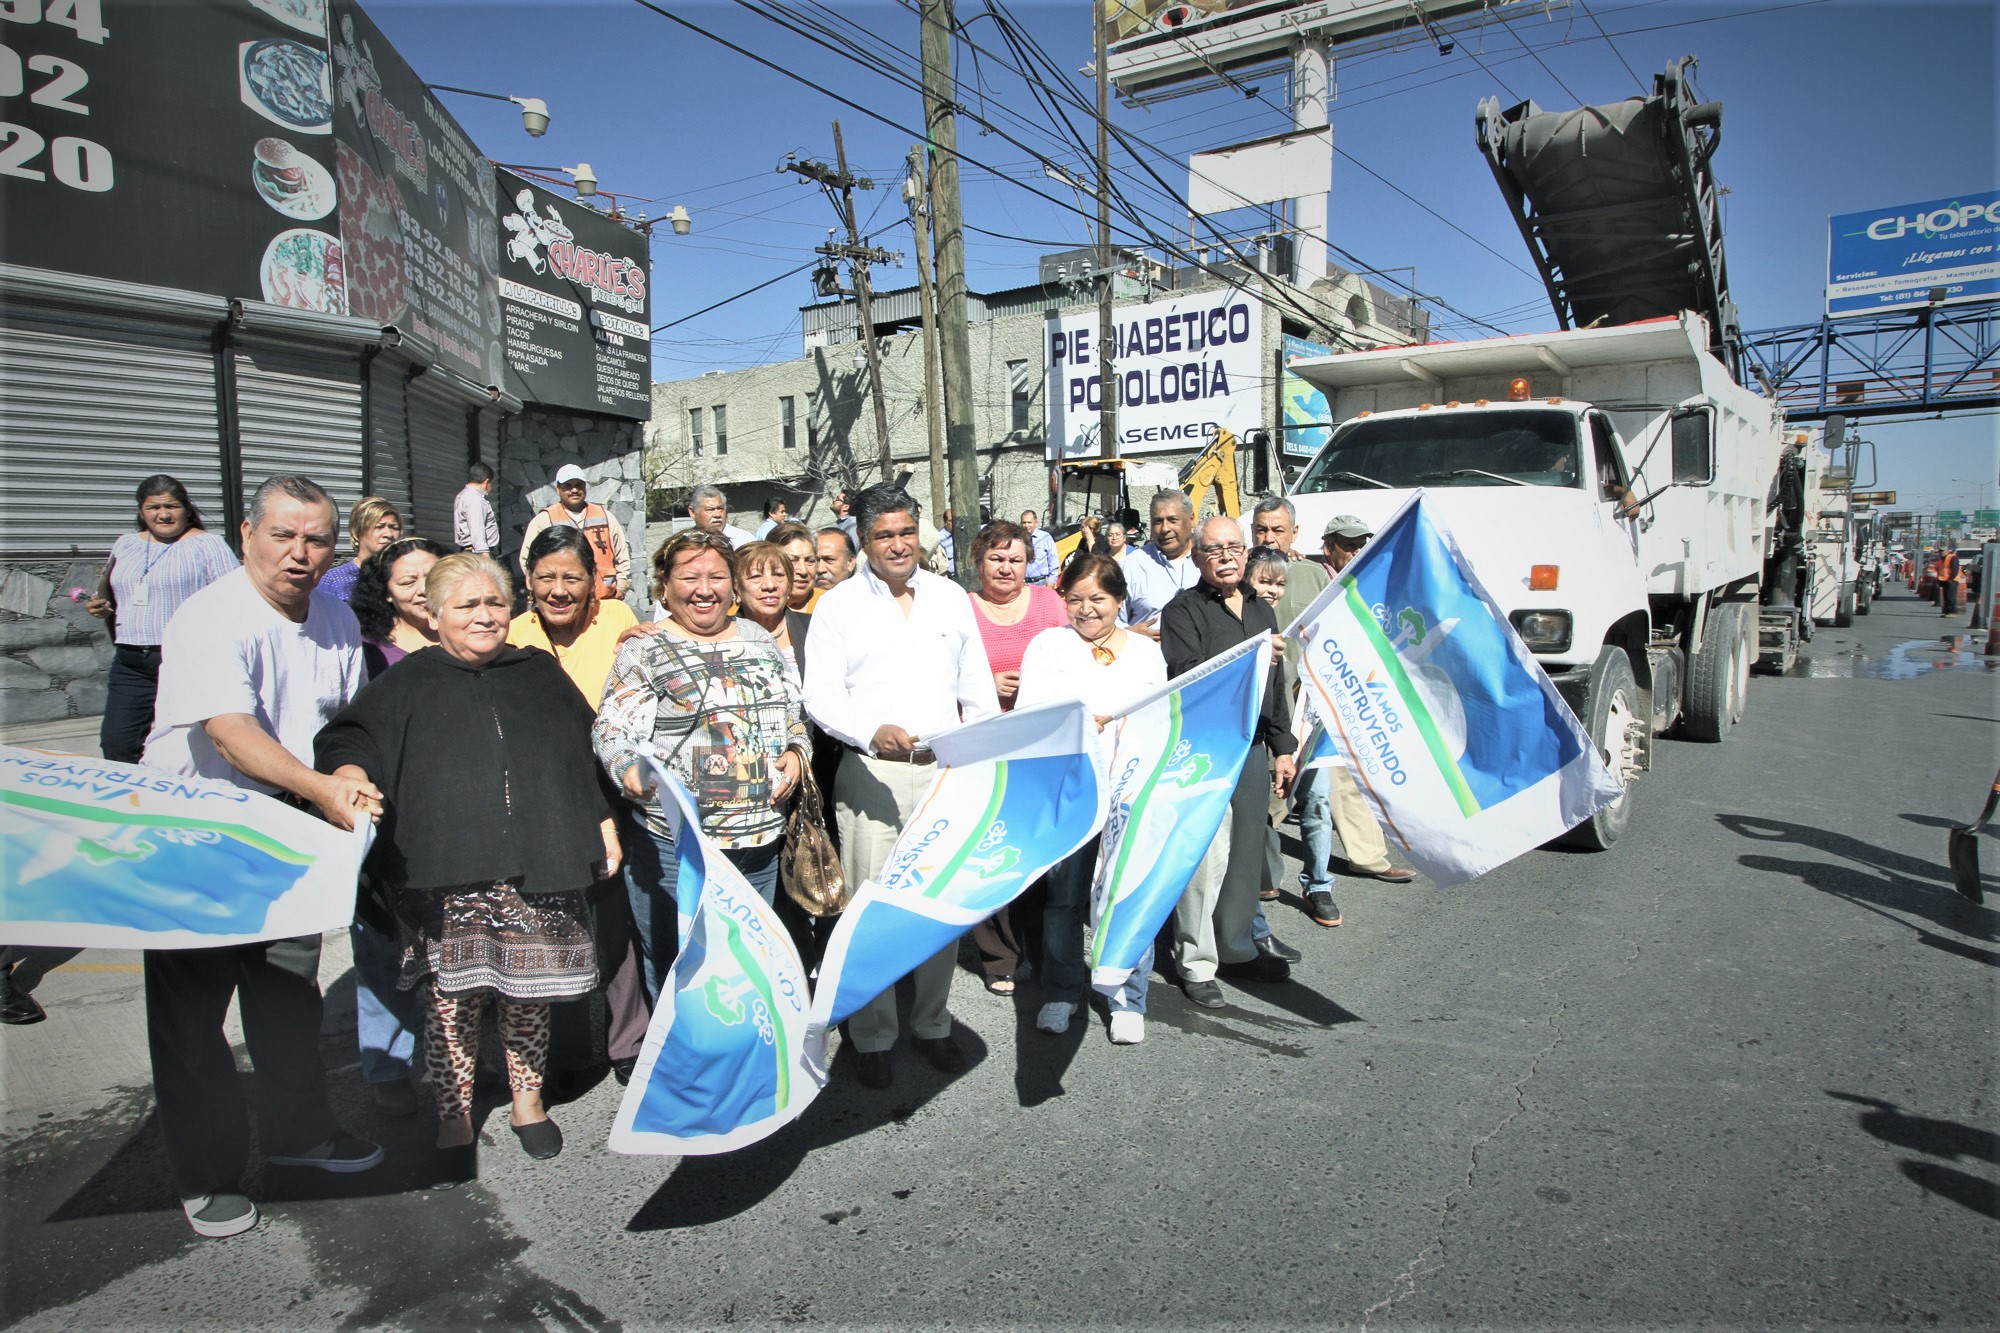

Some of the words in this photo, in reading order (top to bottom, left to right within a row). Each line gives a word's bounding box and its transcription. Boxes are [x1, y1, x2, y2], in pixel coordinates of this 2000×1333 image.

[0, 122, 113, 192] 20
[442, 136, 467, 175] TODOS
[428, 139, 444, 168] LOS
[445, 158, 480, 206] PARTIDOS
[1949, 228, 1992, 239] laboratorio
[401, 209, 479, 287] 83.32.95.94
[1902, 249, 1967, 267] ¡Llegamos
[1969, 245, 1993, 254] con
[404, 236, 479, 307] 83.52.13.92
[548, 239, 645, 299] CHARLIE'S
[1836, 270, 1878, 281] Servicios:
[404, 260, 481, 328] 83.52.39.20
[591, 288, 616, 307] pizza
[1842, 282, 1885, 293] Resonancia
[1895, 292, 1911, 301] (81)
[504, 282, 513, 296] A
[514, 285, 527, 300] LA
[528, 290, 578, 317] PARRILLA:
[506, 304, 548, 323] ARRACHERA
[547, 316, 553, 325] Y
[554, 318, 579, 333] SIRLOIN
[506, 315, 535, 331] PIRATAS
[600, 314, 644, 338] BOTANAS:
[507, 326, 530, 340] TACOS
[596, 329, 624, 346] ALITAS
[507, 338, 563, 360] HAMBURGUESAS
[508, 349, 525, 361] PAPA
[525, 354, 548, 366] ASADA
[622, 350, 647, 363] FRANCESA
[1052, 328, 1090, 367] PIE
[596, 353, 626, 368] GUACAMOLE
[596, 363, 614, 375] QUESO
[614, 368, 640, 381] FLAMEADO
[597, 373, 614, 385] DEDOS
[615, 379, 622, 387] DE
[622, 380, 639, 390] QUESO
[1071, 351, 1230, 412] POOLOGÍA
[625, 390, 650, 402] RELLENOS
[1323, 639, 1406, 786] CONSTRUYENDO
[1365, 669, 1403, 733] VAMOS
[1330, 681, 1356, 726] MEJOR
[1349, 726, 1380, 776] CIUDAD
[885, 819, 949, 889] CONSTR
